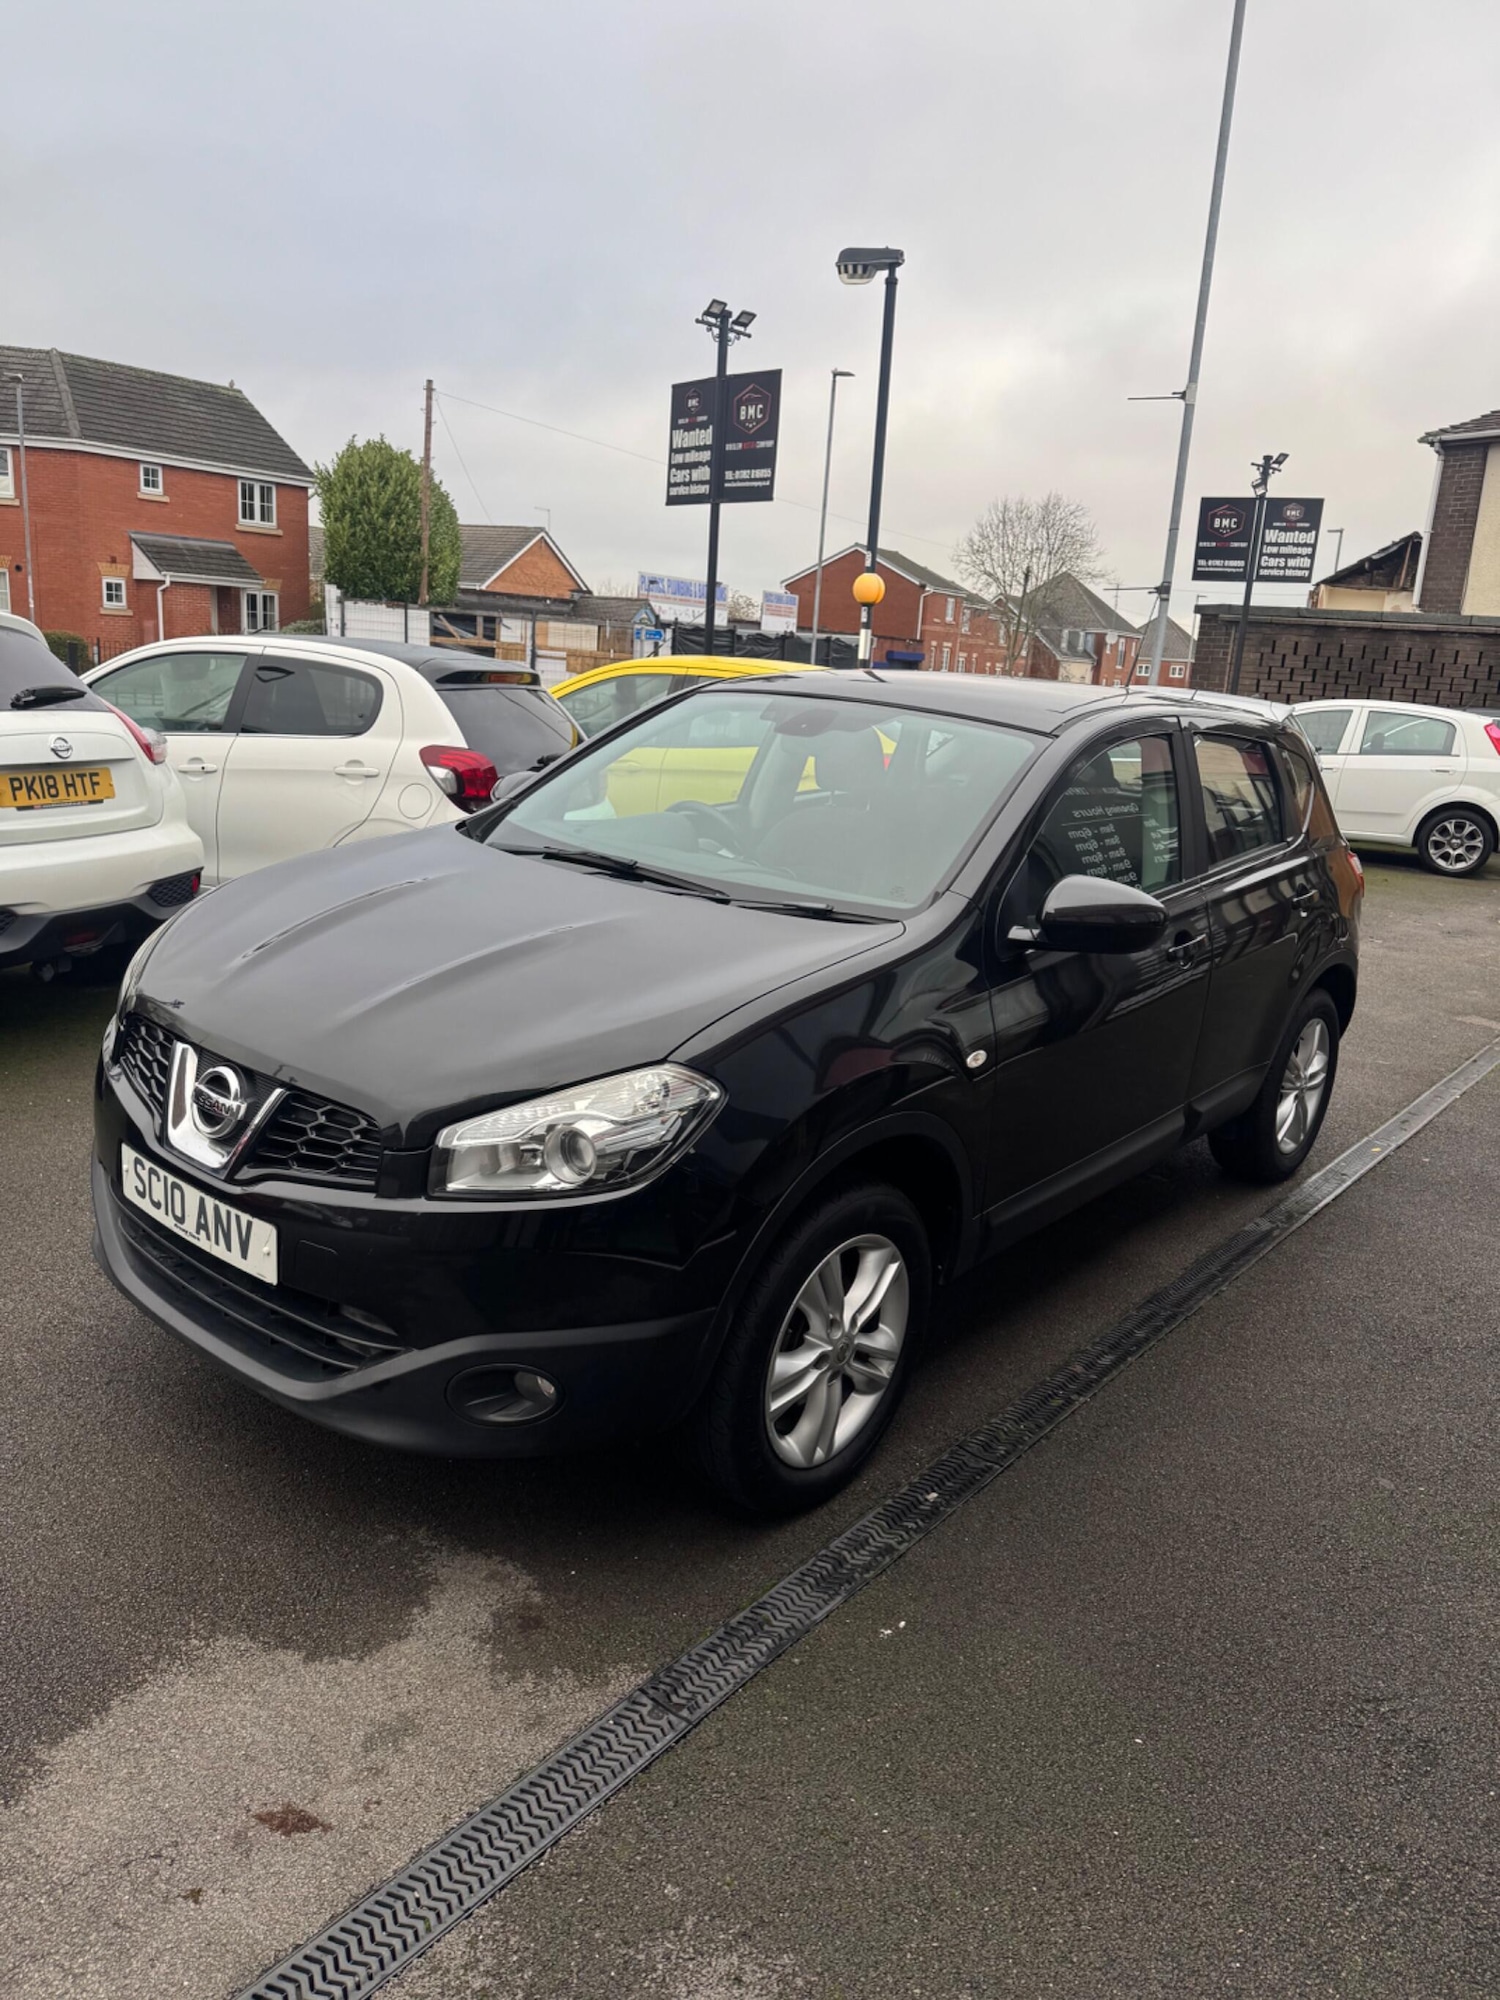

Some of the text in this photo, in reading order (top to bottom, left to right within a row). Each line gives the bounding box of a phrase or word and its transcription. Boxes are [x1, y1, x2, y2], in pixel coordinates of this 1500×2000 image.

[688, 398, 700, 407] BMC
[740, 404, 763, 419] BMC
[672, 424, 713, 449] Wanted
[671, 449, 711, 464] Low mileage
[670, 465, 711, 483] Cars with
[669, 483, 710, 496] service history
[1213, 517, 1238, 528] BMC
[1264, 529, 1316, 544] Wanted
[1262, 545, 1313, 556] Low mileage
[1261, 555, 1312, 568] Cars with
[1259, 568, 1310, 577] service history
[8, 772, 100, 801] PK18 HTF
[133, 1156, 253, 1261] SC10 ANV
